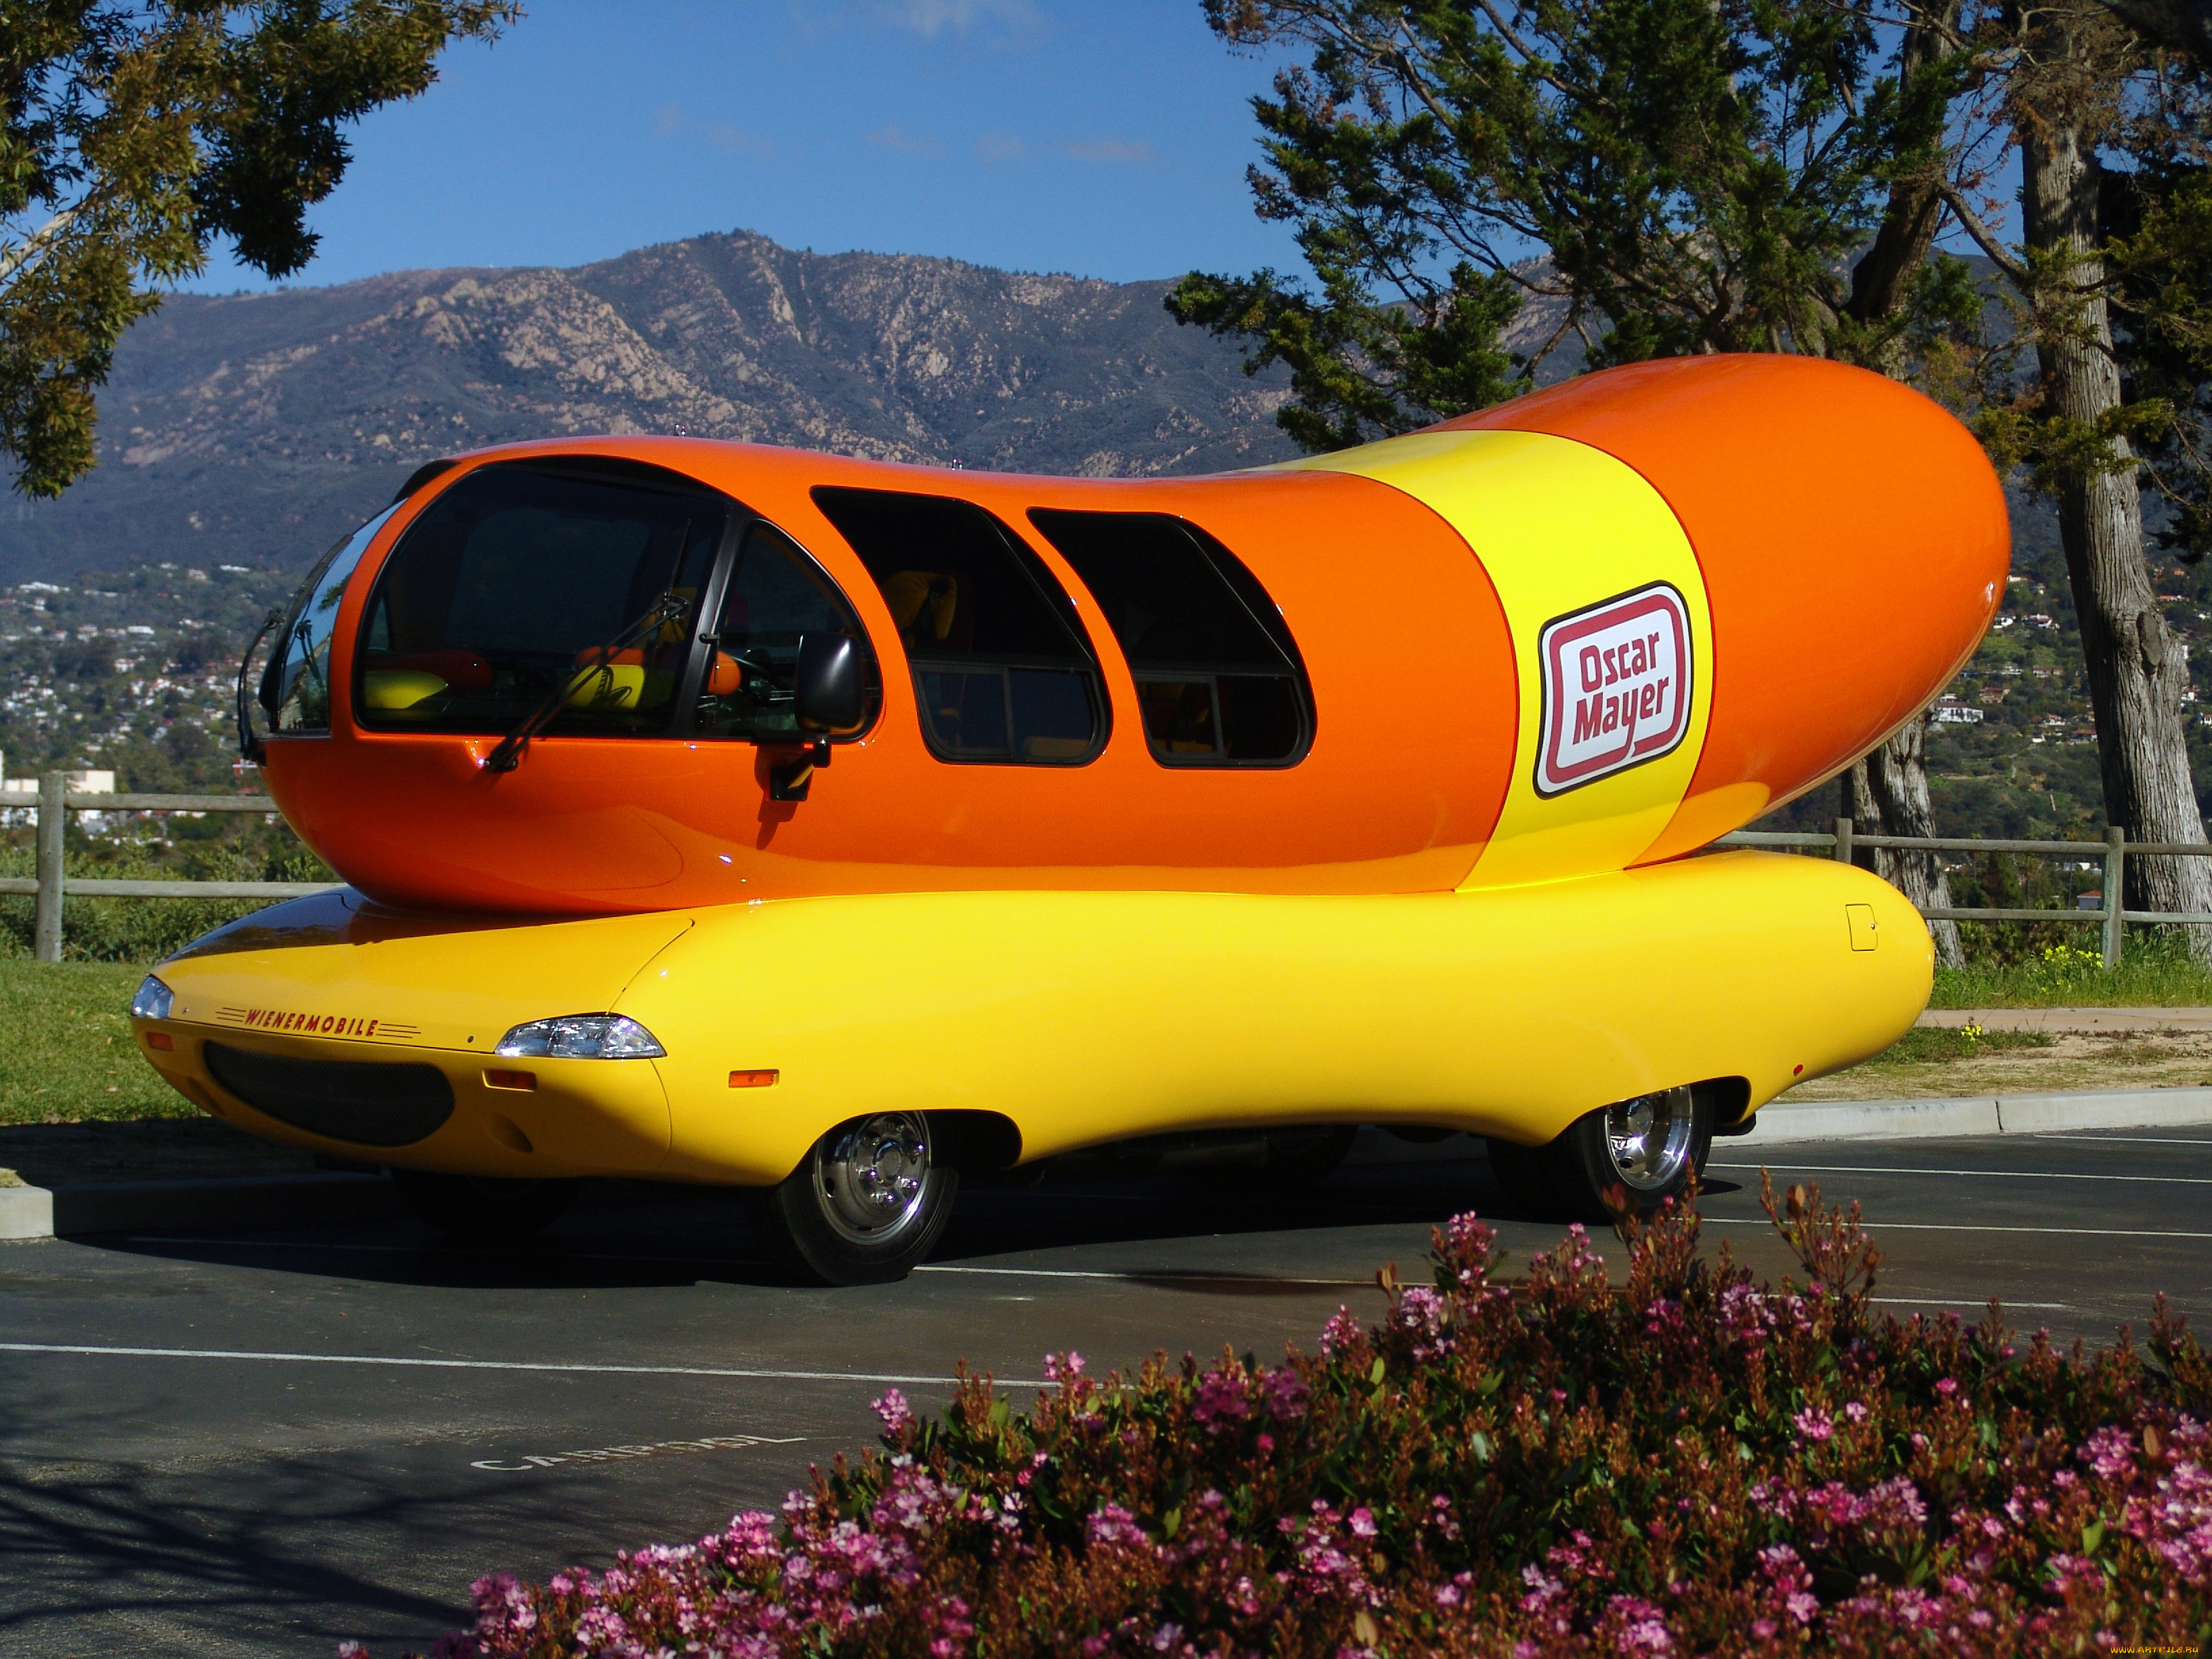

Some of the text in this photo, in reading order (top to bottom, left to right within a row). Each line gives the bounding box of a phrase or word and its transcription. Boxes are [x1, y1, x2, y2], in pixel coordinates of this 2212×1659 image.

[1579, 631, 1660, 694] Oscar
[1572, 676, 1670, 748] Mayer
[244, 1008, 379, 1038] WIENERMOBILE
[470, 1433, 808, 1472] CARPOOL
